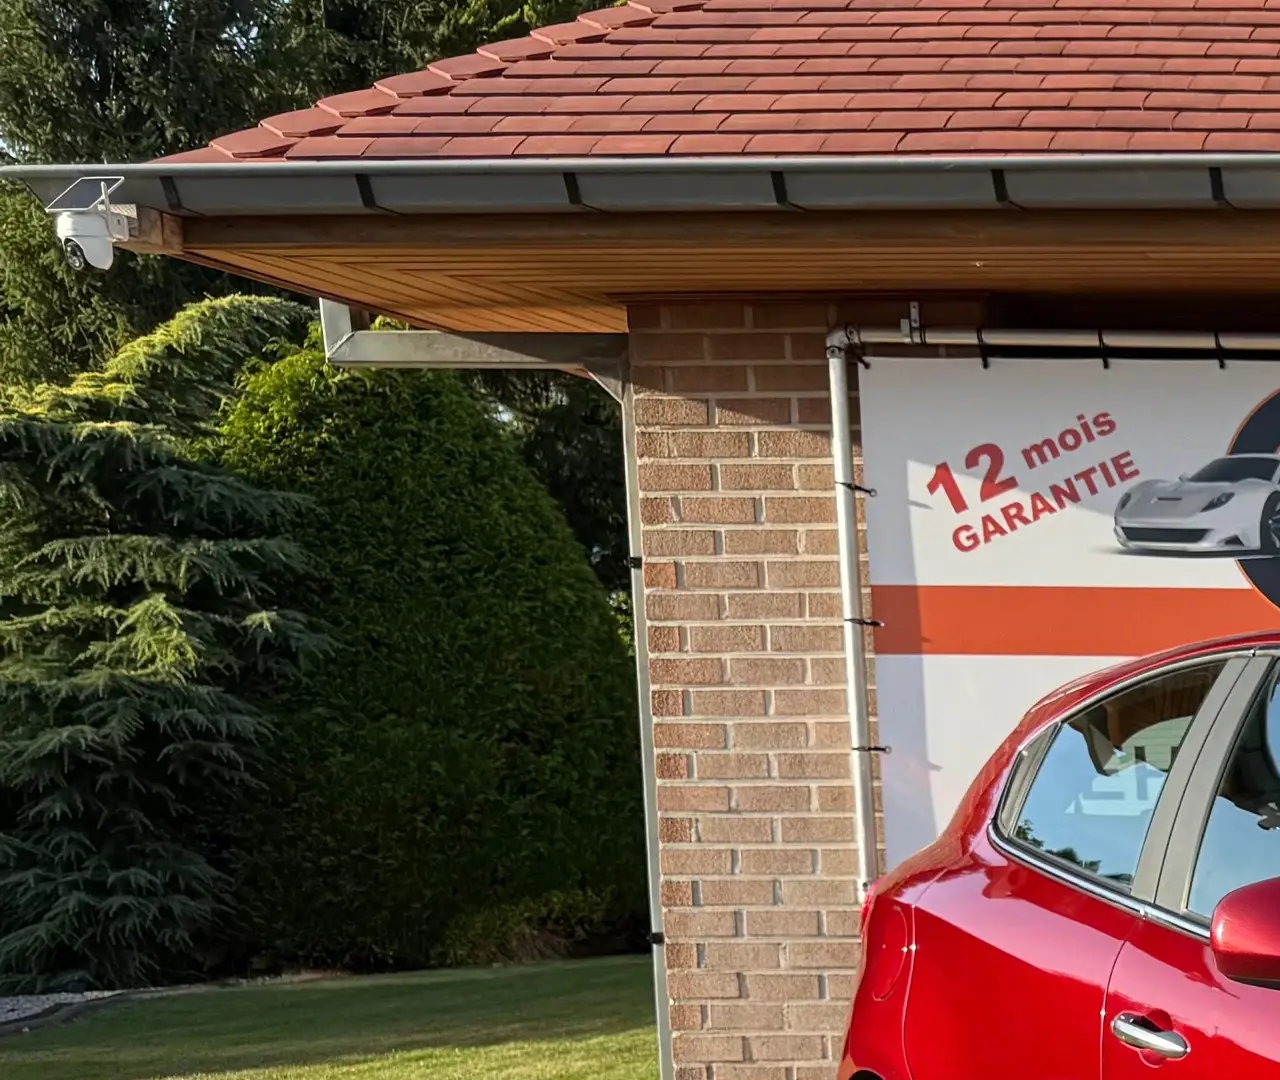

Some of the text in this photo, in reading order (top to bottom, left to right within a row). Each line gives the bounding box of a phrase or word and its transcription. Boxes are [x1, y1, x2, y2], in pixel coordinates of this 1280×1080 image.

[927, 410, 1117, 513] 12 mois
[952, 451, 1141, 552] GARANTIE
